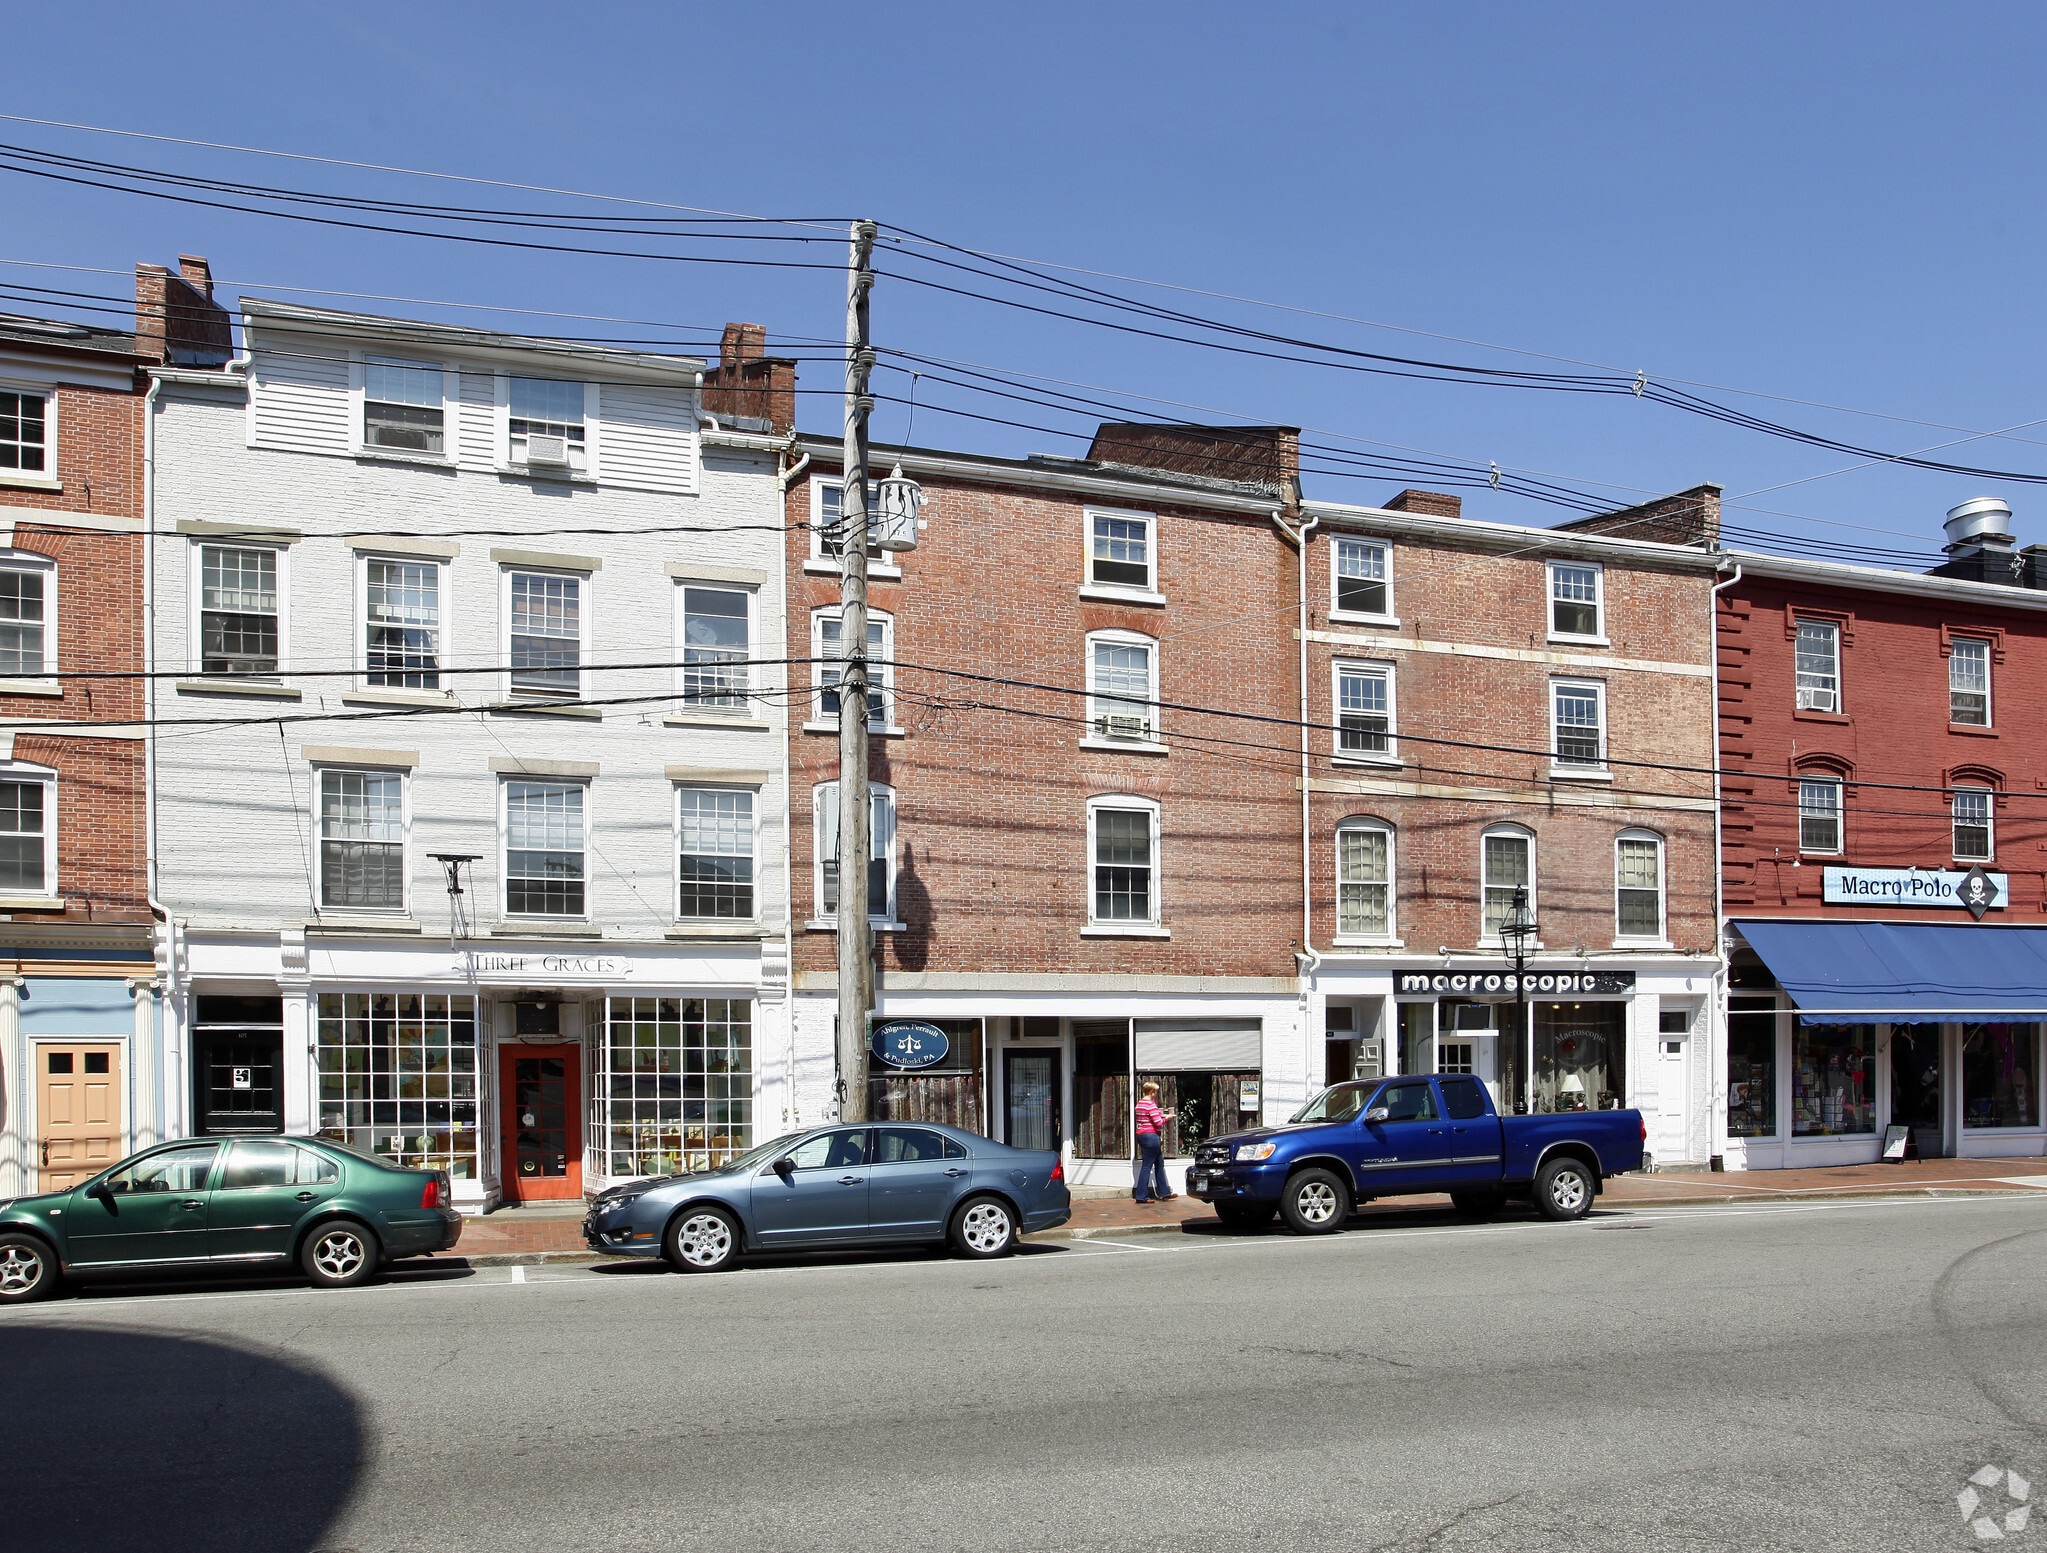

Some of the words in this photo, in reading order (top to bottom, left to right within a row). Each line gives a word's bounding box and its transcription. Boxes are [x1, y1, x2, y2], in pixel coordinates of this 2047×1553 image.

[1841, 876, 1901, 895] Macro
[1911, 878, 1951, 897] Polo
[471, 954, 529, 971] THREE
[543, 956, 615, 972] GRACES
[1402, 974, 1596, 993] macroscopic
[1555, 1030, 1606, 1043] Macroscopic
[923, 1053, 935, 1062] PA
